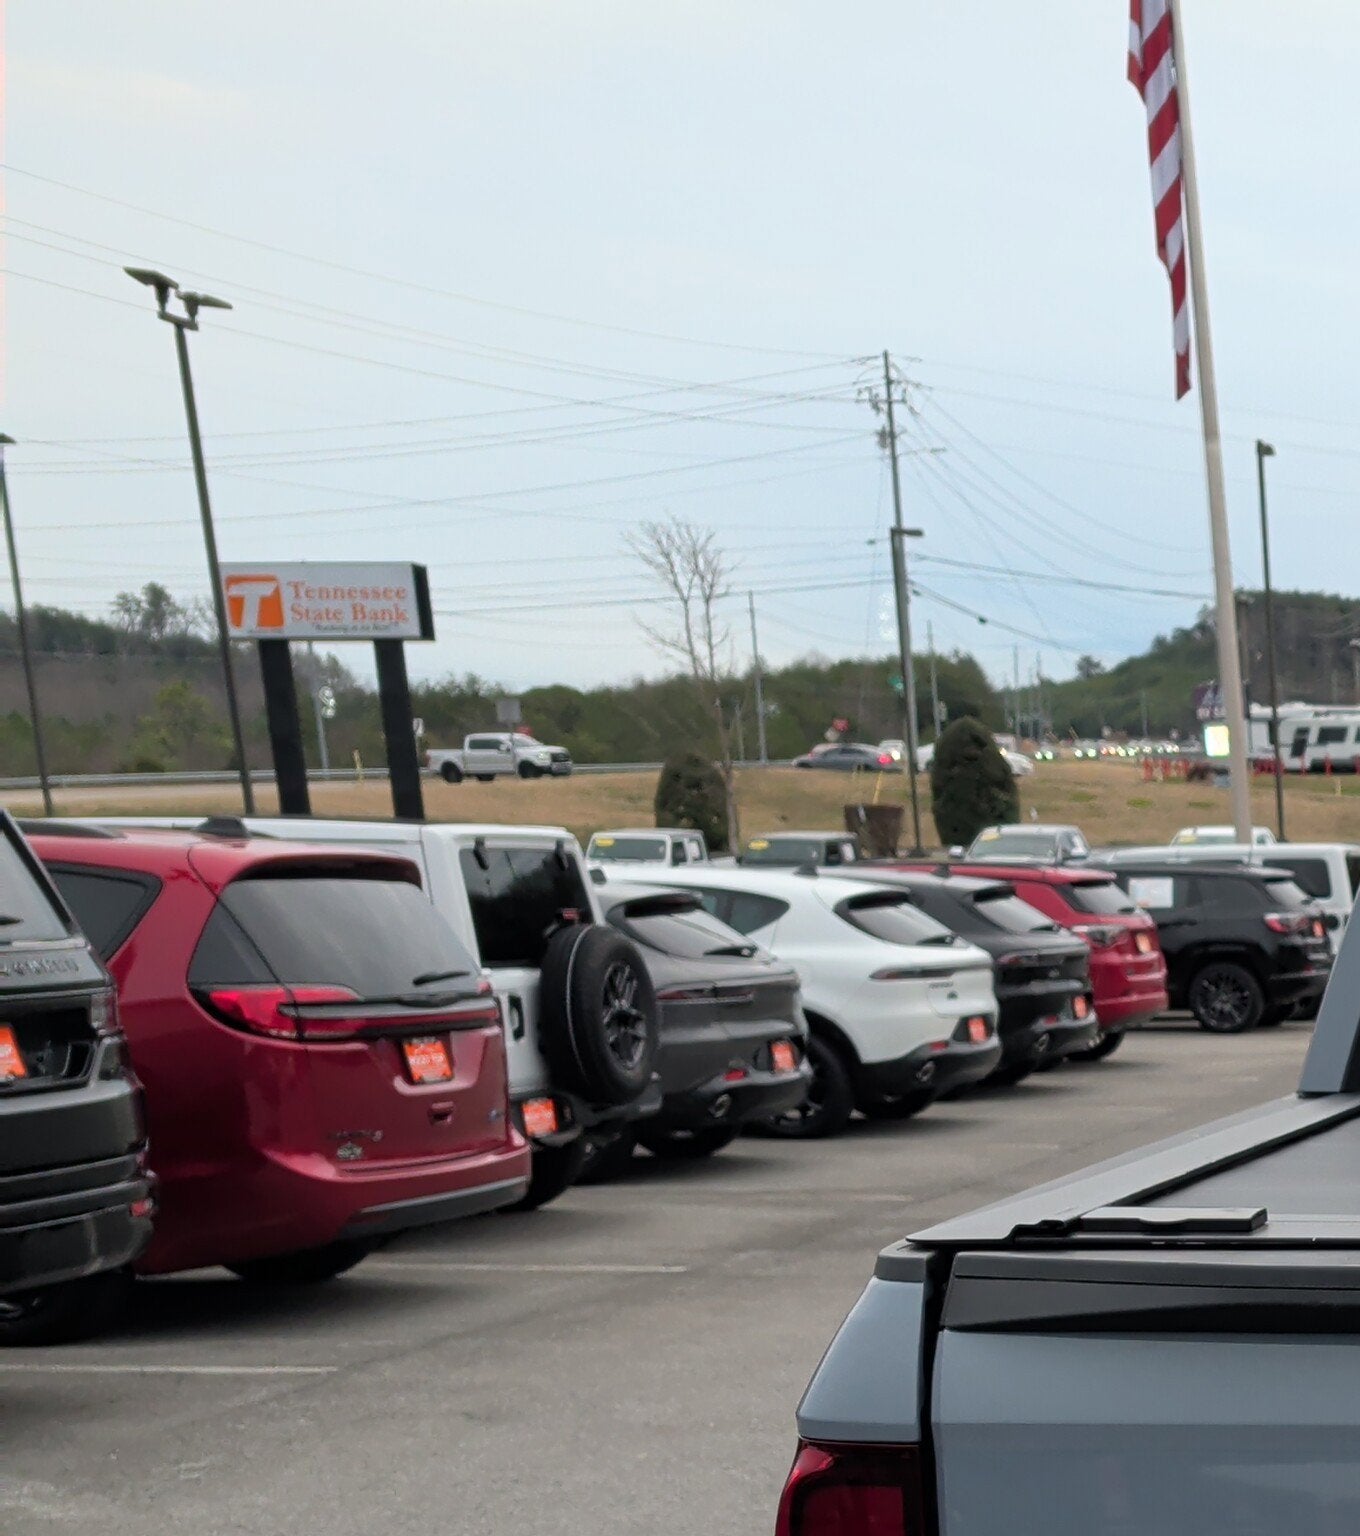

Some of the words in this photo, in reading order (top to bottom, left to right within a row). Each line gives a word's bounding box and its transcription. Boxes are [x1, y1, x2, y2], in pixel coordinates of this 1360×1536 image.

[288, 580, 407, 600] Tennessee
[290, 603, 343, 623] State
[352, 602, 409, 623] Bank
